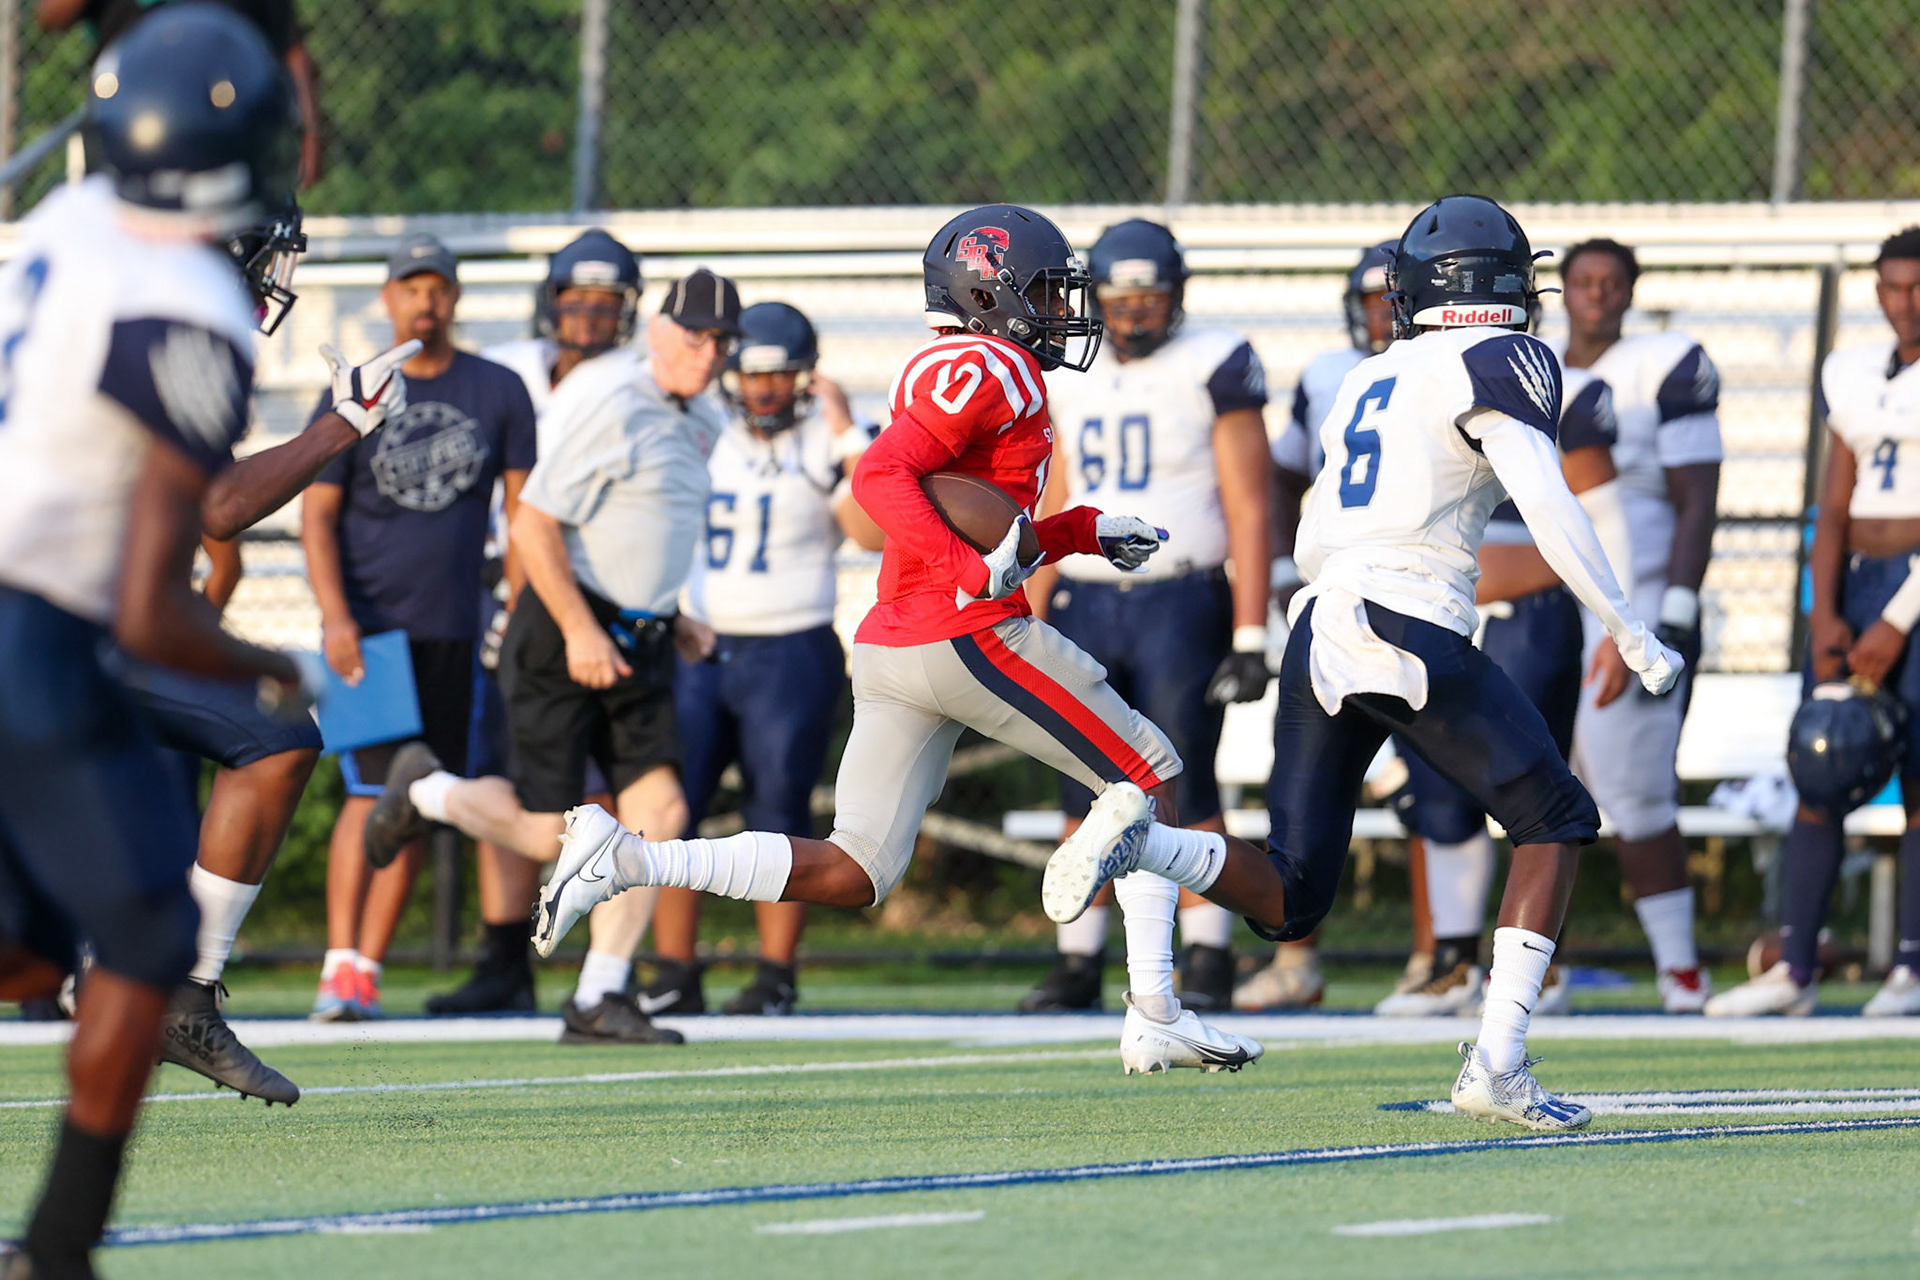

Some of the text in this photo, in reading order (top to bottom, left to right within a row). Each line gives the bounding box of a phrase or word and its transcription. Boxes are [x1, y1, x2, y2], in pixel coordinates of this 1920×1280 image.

[1442, 308, 1512, 323] Riddell
[1079, 415, 1150, 492] 60
[1339, 374, 1398, 512] 6
[1871, 438, 1898, 490] 4
[704, 492, 771, 572] 61
[165, 1025, 216, 1067] adidas
